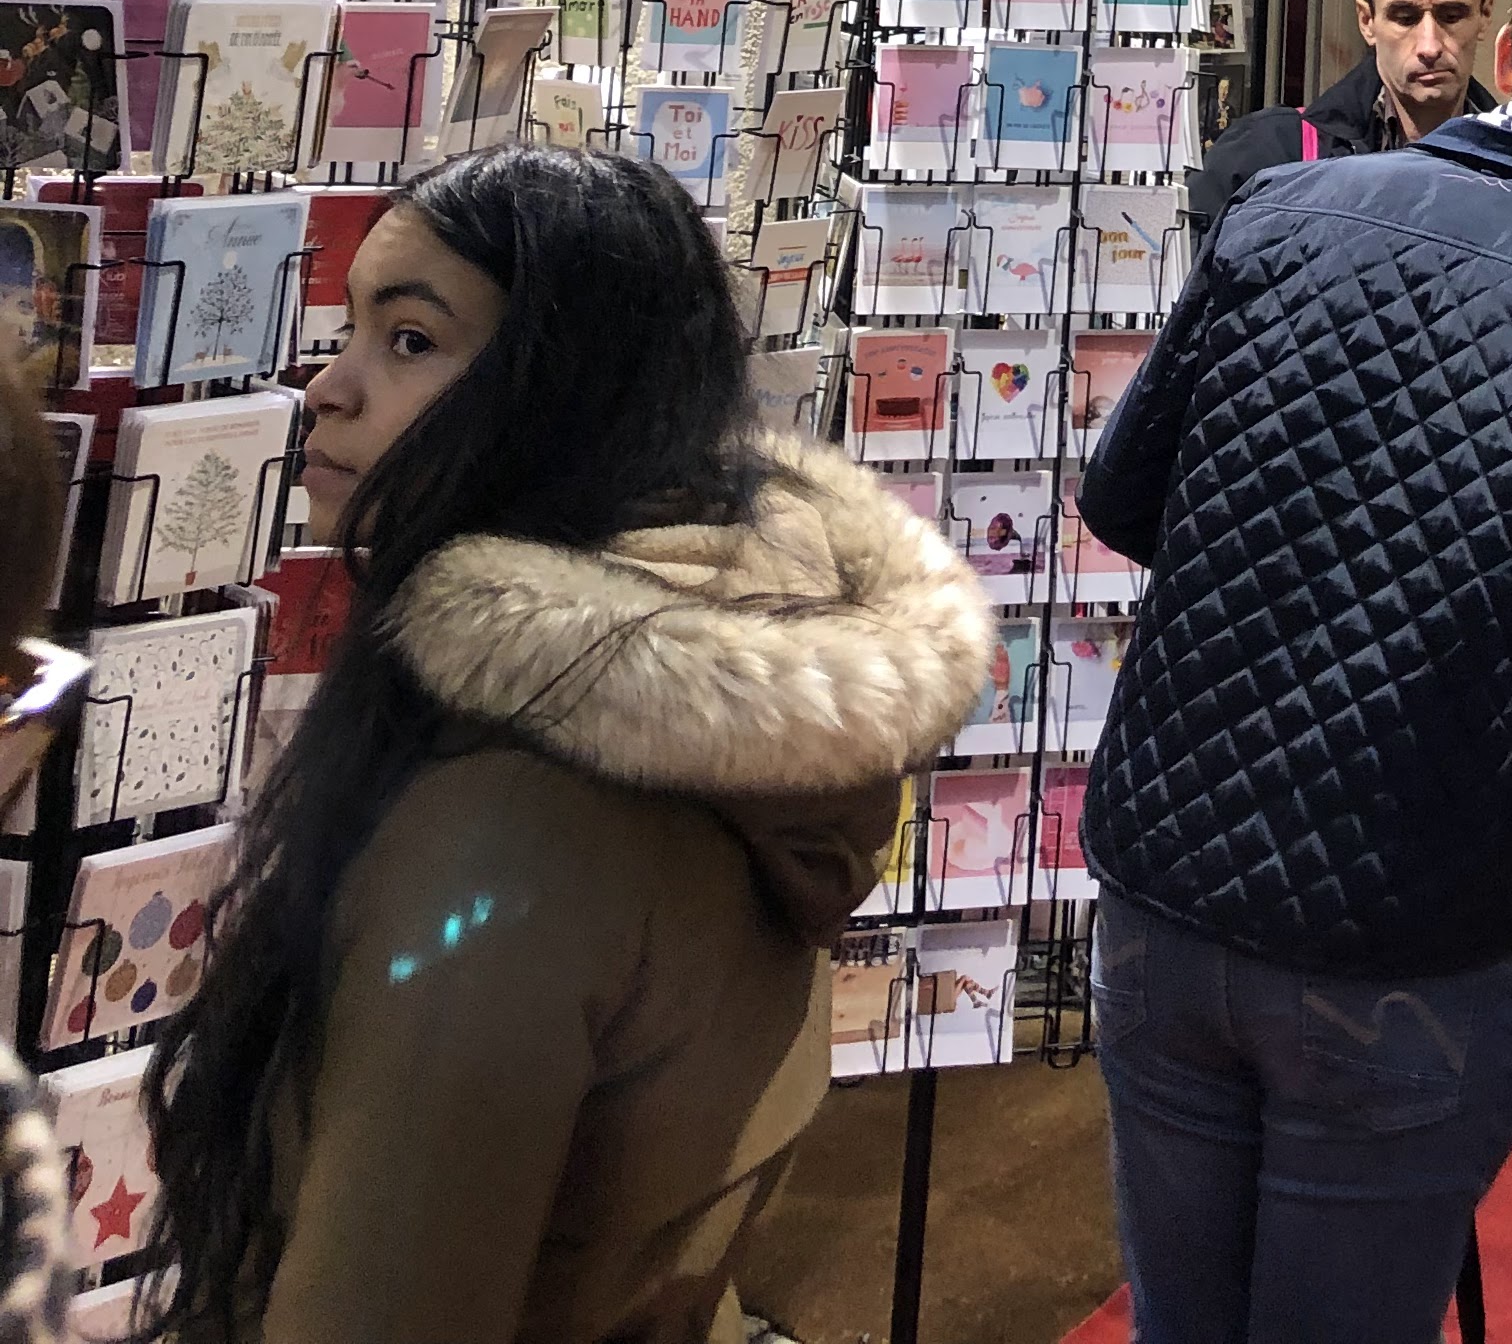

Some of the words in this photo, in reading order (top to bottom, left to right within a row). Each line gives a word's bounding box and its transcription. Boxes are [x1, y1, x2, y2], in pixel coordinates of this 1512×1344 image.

[669, 7, 721, 28] HAND
[668, 104, 702, 124] Toi
[663, 142, 698, 162] Moi
